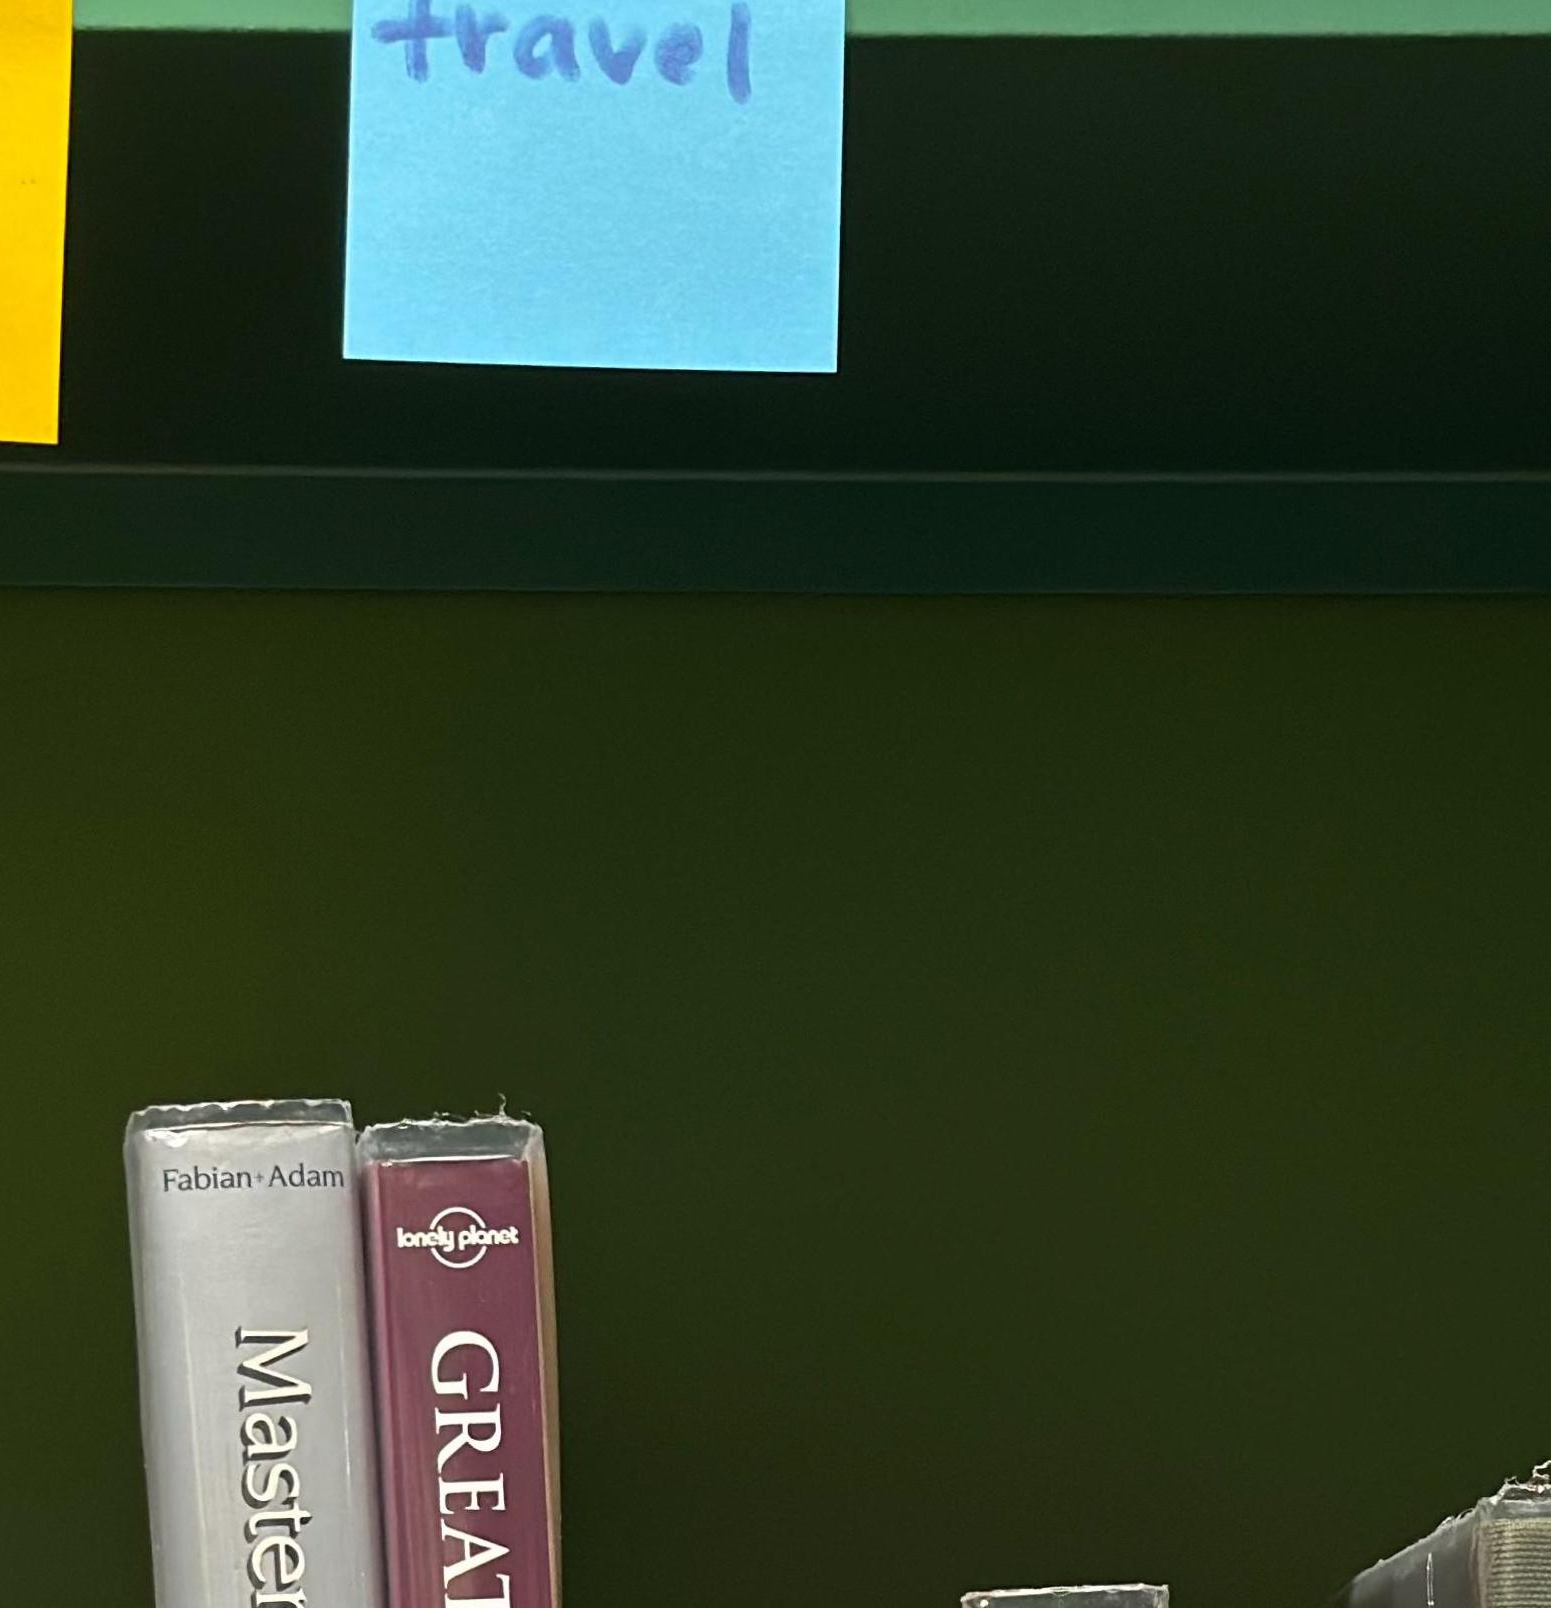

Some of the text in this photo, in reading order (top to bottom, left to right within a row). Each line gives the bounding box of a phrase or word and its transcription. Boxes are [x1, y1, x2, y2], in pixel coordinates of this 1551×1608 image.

[370, 0, 753, 104] travel
[396, 1225, 520, 1251] lonely planet
